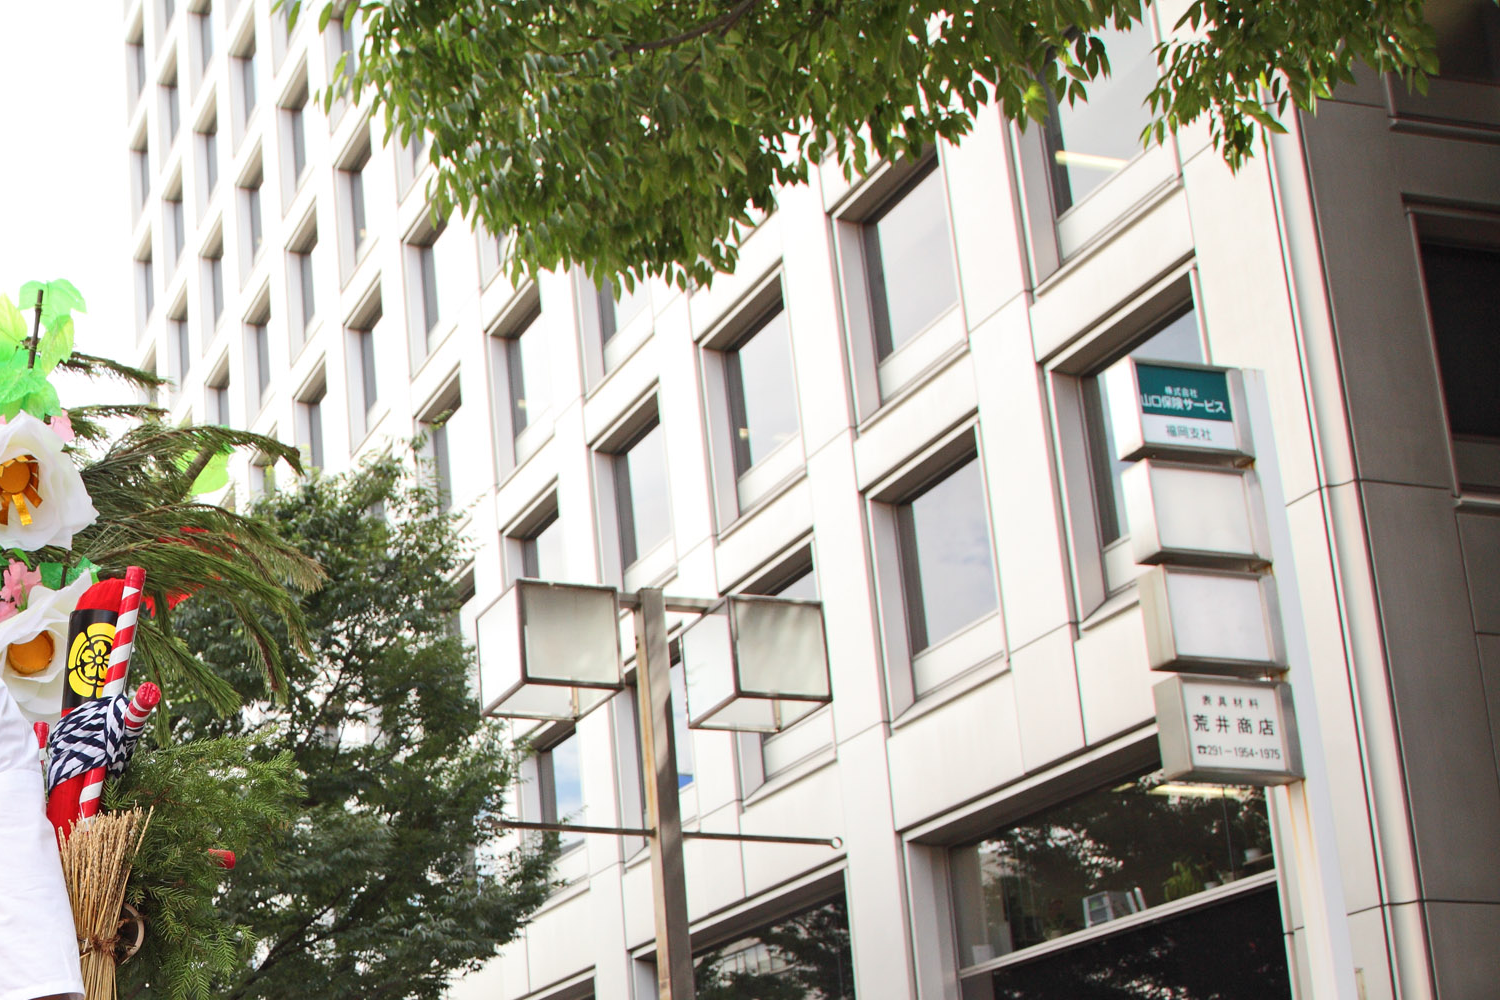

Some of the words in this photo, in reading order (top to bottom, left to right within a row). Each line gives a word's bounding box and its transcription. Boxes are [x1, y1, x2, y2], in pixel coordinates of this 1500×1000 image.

[1140, 394, 1227, 414] 山口保険サービス
[1166, 424, 1213, 441] 福岡支社
[1193, 714, 1275, 736] 荒井商店
